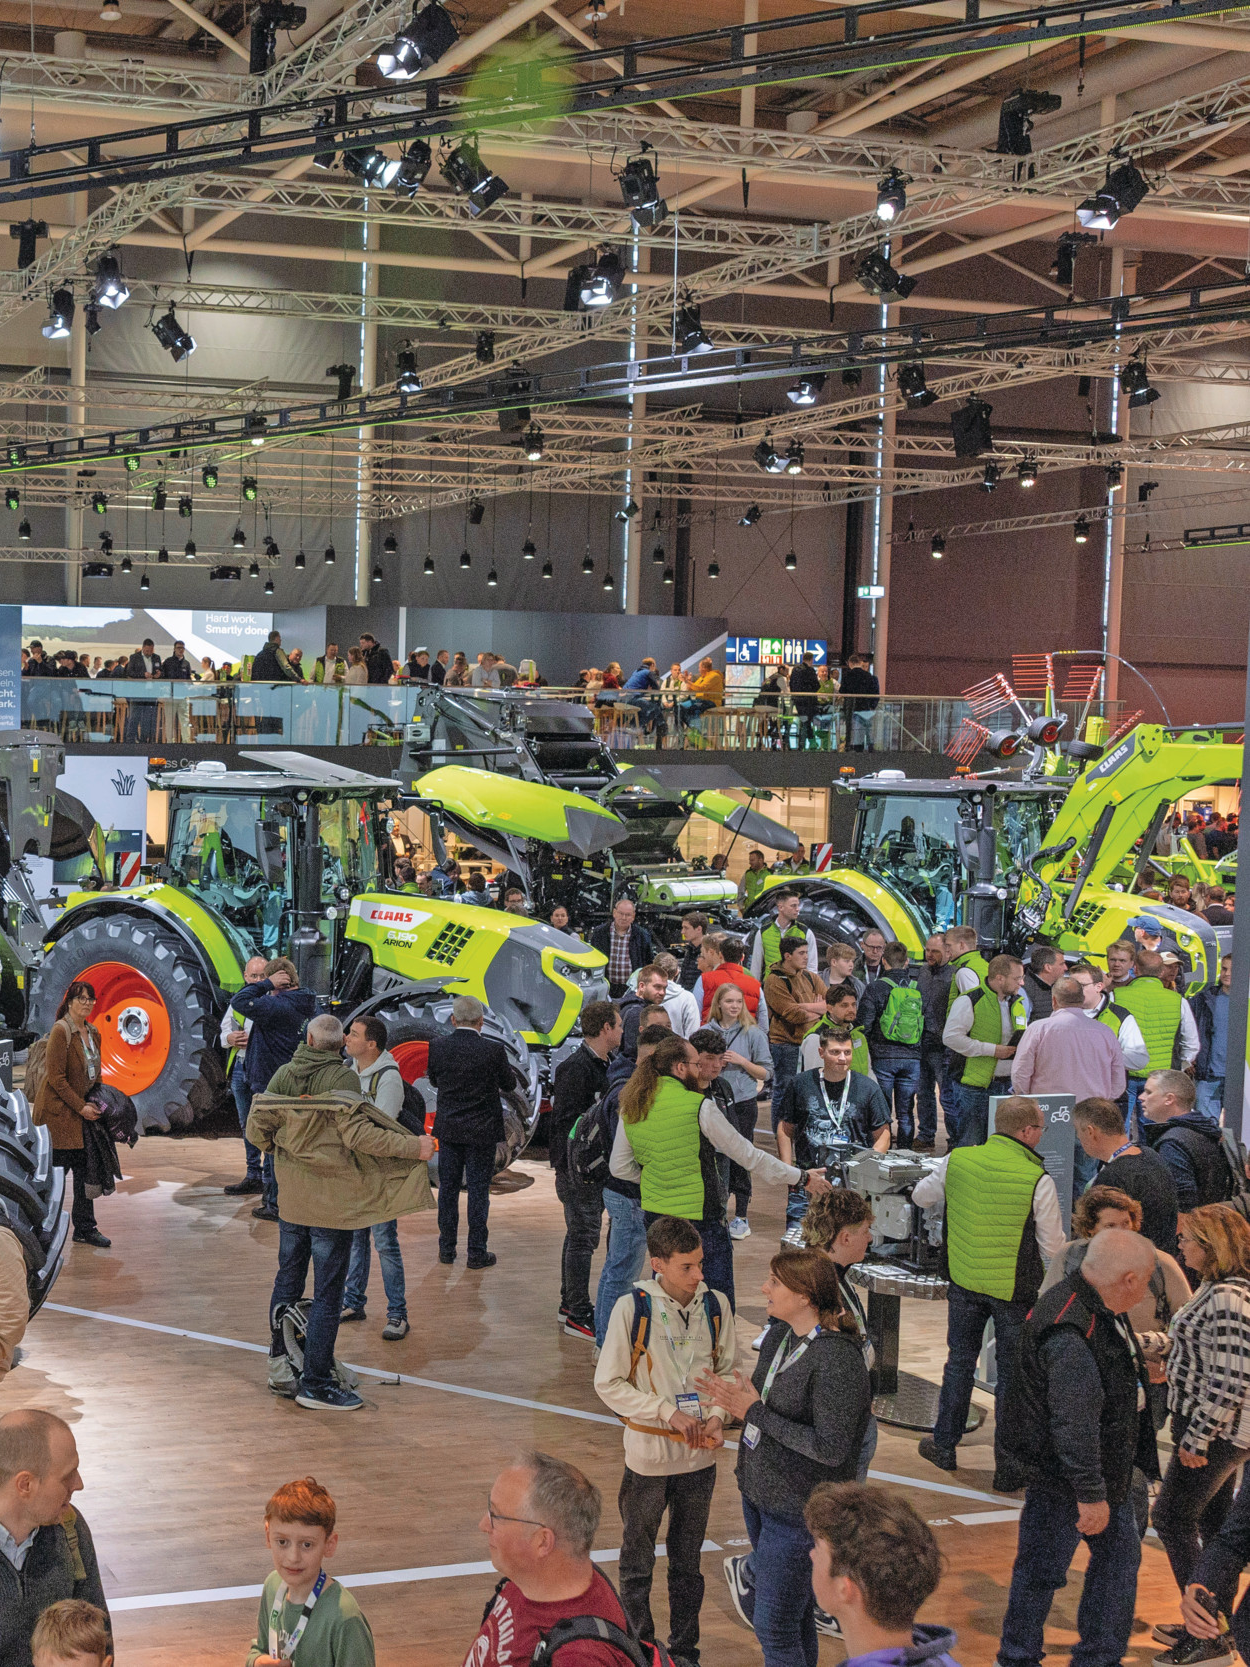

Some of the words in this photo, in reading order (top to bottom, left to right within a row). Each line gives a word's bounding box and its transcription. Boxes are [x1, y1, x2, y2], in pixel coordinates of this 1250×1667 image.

[205, 613, 229, 623] Hard
[231, 614, 257, 624] work.
[205, 625, 242, 637] Smartly
[1098, 744, 1129, 774] CLAAS
[370, 909, 414, 923] CLAAS
[387, 930, 419, 943] 6.190
[382, 938, 413, 949] ARION
